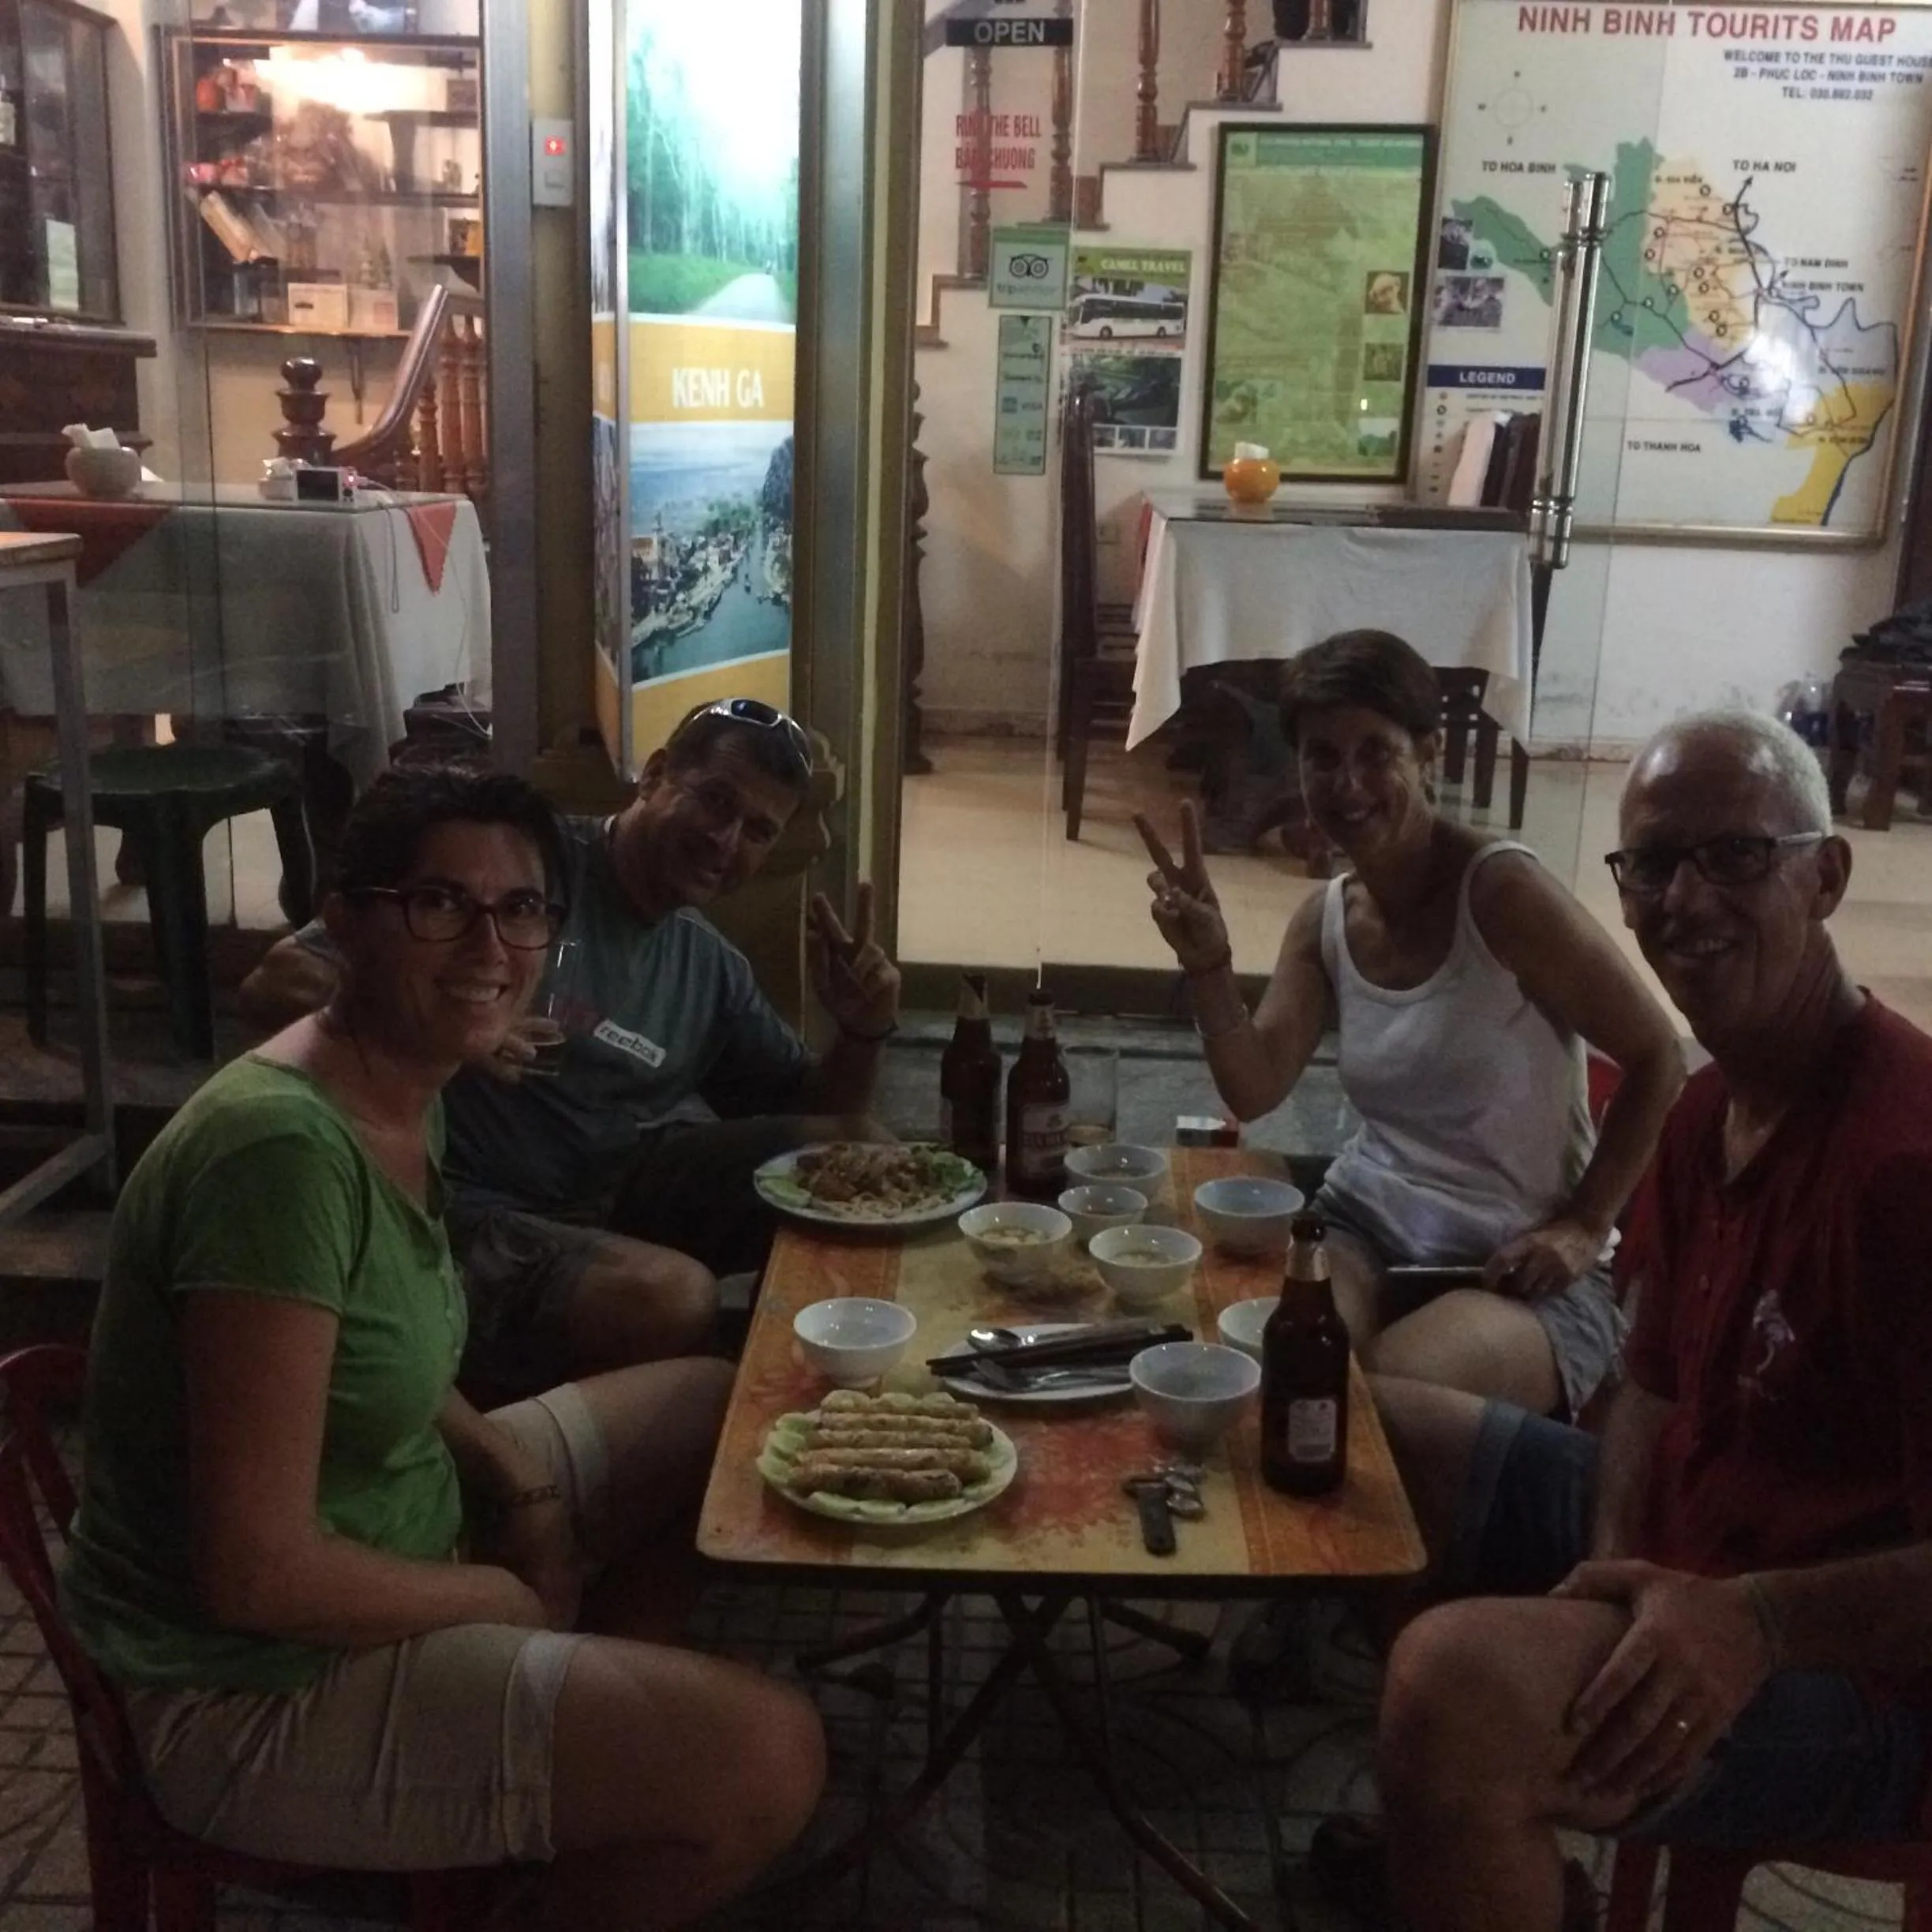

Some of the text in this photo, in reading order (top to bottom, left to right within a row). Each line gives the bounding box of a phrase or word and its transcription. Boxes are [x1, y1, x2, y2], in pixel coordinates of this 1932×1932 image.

[974, 21, 1045, 43] OPEN
[1518, 6, 1897, 42] NINH BINH TOURITS MAP
[1724, 49, 1781, 63] WELCOME
[1785, 51, 1801, 64] TO
[1803, 52, 1825, 65] THE
[1013, 116, 1041, 138] BELL
[1482, 160, 1498, 171] TO
[1733, 160, 1796, 172] TO HA NOI
[1460, 371, 1515, 384] LEGEND
[672, 368, 765, 409] KENH GA
[1627, 441, 1641, 451] TO
